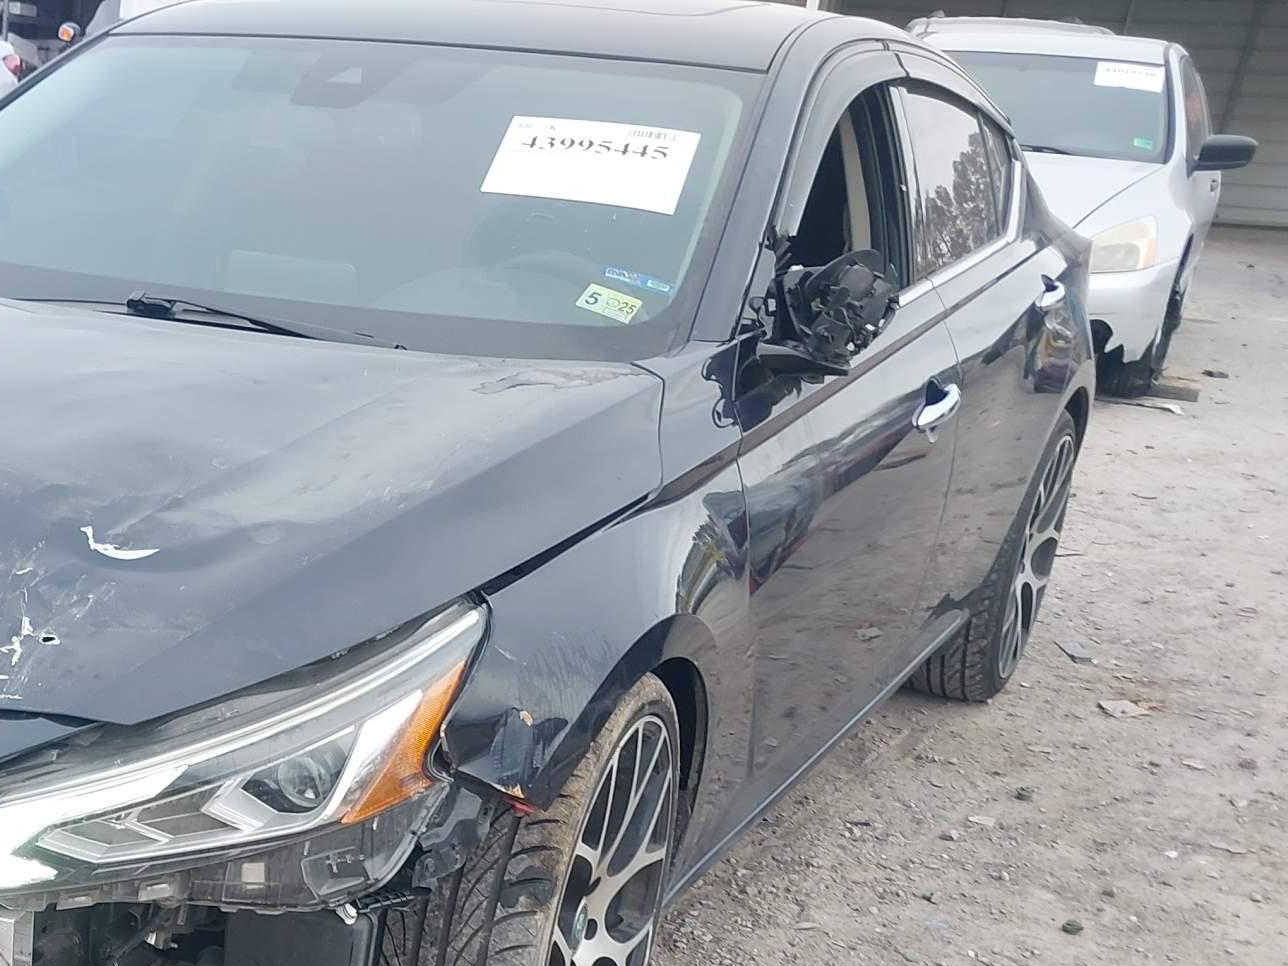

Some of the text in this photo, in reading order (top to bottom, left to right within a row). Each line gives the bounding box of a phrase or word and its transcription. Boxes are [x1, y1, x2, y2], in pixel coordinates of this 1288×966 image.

[521, 136, 670, 159] 43995445
[585, 291, 602, 306] 5
[618, 302, 637, 315] 25
